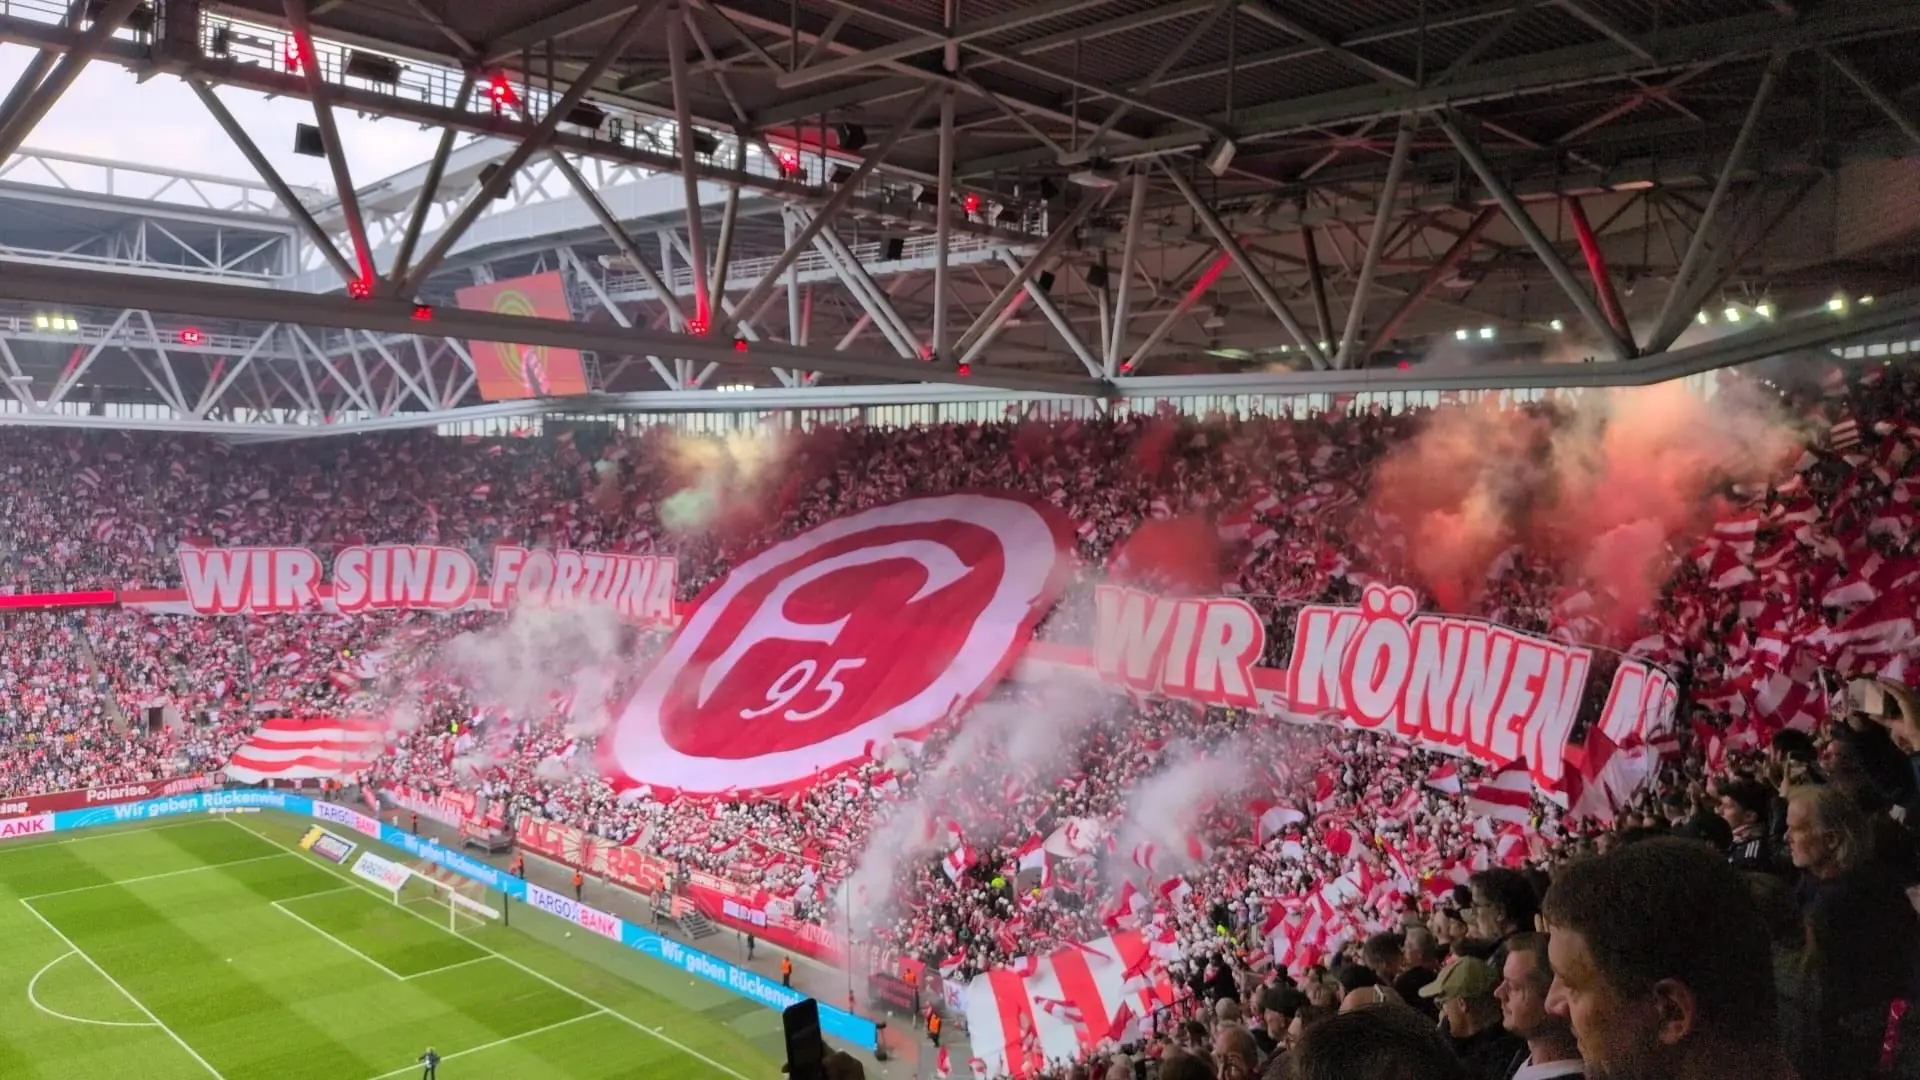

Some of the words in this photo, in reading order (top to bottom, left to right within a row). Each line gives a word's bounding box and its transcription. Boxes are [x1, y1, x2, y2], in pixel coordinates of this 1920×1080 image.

[179, 548, 321, 613] WIR
[336, 547, 476, 612] SIND
[491, 547, 677, 623] FORTUNA
[740, 657, 867, 722] 95
[1096, 587, 1263, 707] WIR
[1289, 586, 1590, 788] KÖNNEN
[114, 803, 145, 819] Wir
[150, 797, 198, 816] geben
[203, 790, 285, 808] Rückenwind
[660, 937, 684, 963] Wir
[686, 953, 726, 982] geben
